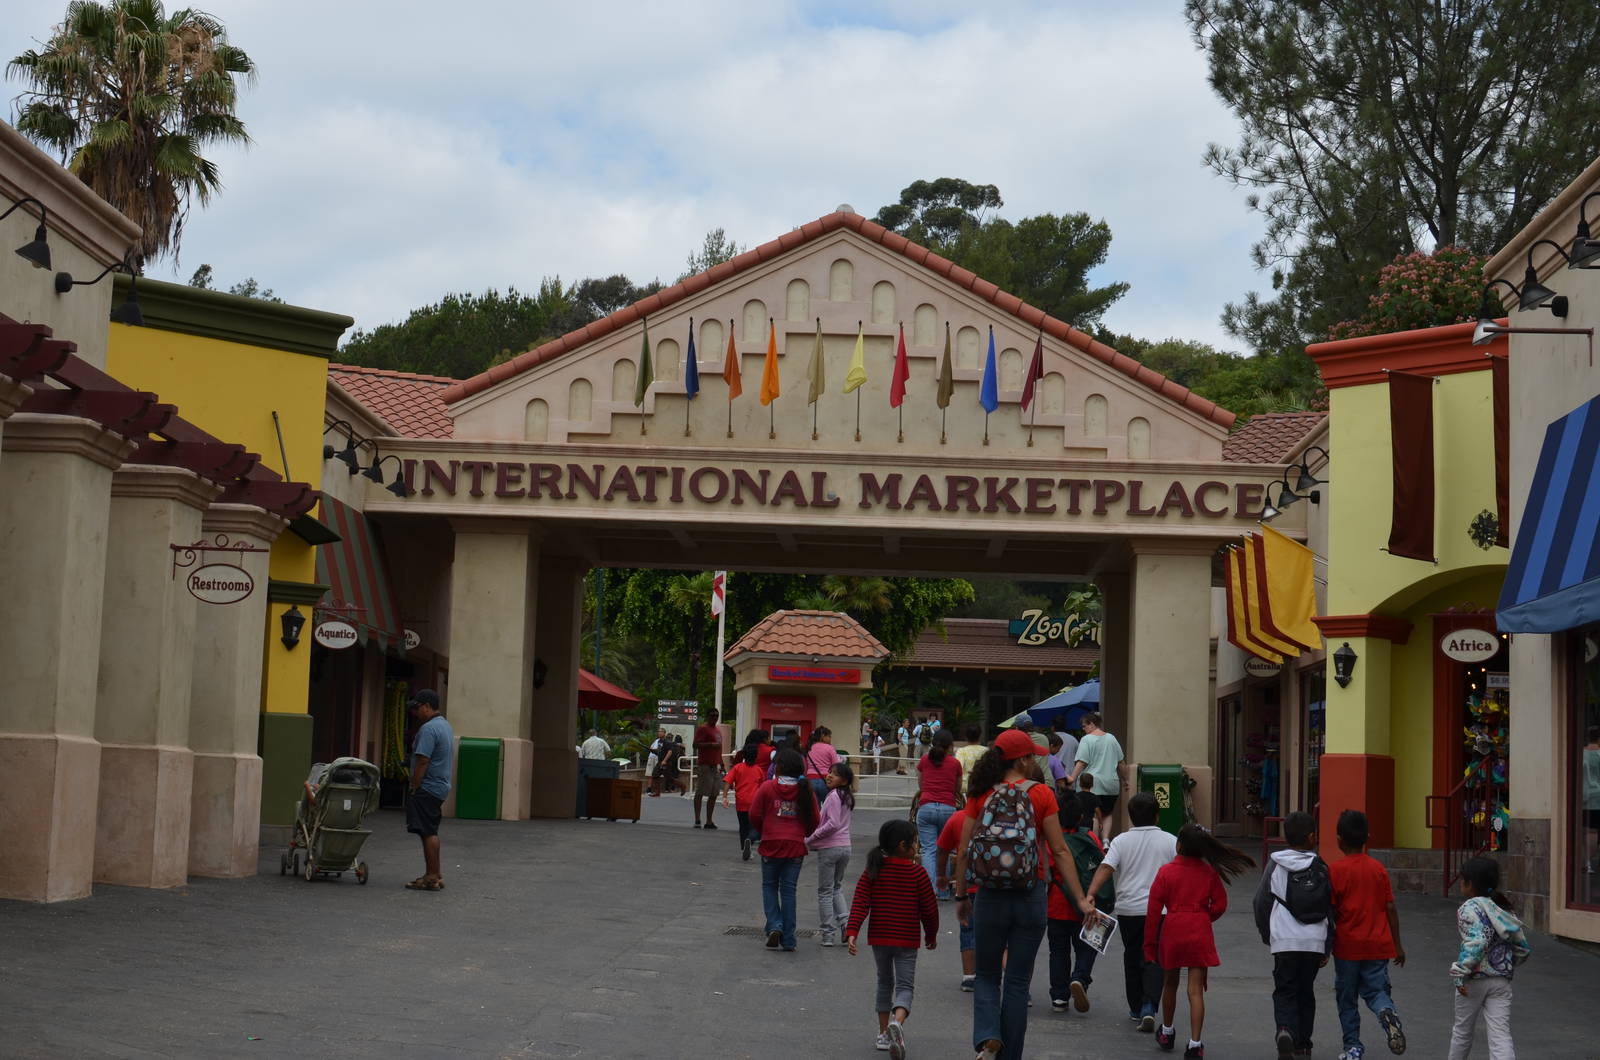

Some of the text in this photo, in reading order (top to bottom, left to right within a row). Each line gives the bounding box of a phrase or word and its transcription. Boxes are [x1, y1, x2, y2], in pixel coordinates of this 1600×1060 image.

[403, 458, 1266, 519] INTERNATIONAL MARKETPLACE
[191, 576, 250, 592] Restrooms
[317, 626, 356, 640] Aquatics
[1017, 608, 1063, 646] Zoo
[1448, 638, 1493, 652] Africa
[1245, 661, 1281, 671] Australia
